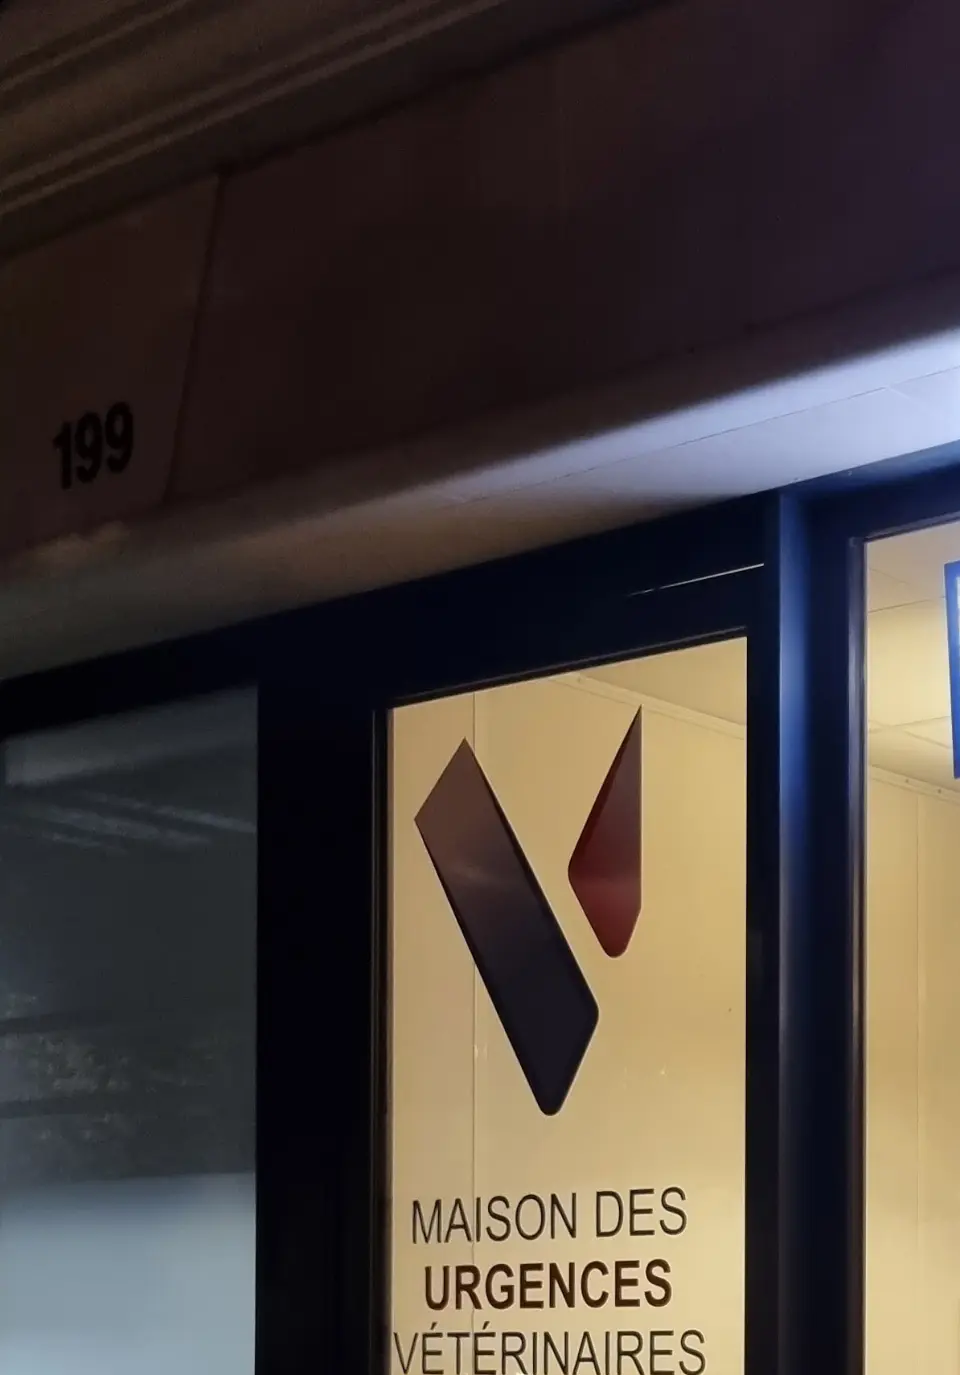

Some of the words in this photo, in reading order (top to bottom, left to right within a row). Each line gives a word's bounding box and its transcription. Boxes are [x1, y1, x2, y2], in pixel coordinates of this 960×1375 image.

[52, 402, 134, 489] 199
[411, 1191, 577, 1244] MAISON
[595, 1186, 687, 1238] DES
[424, 1258, 673, 1311] URGENCES
